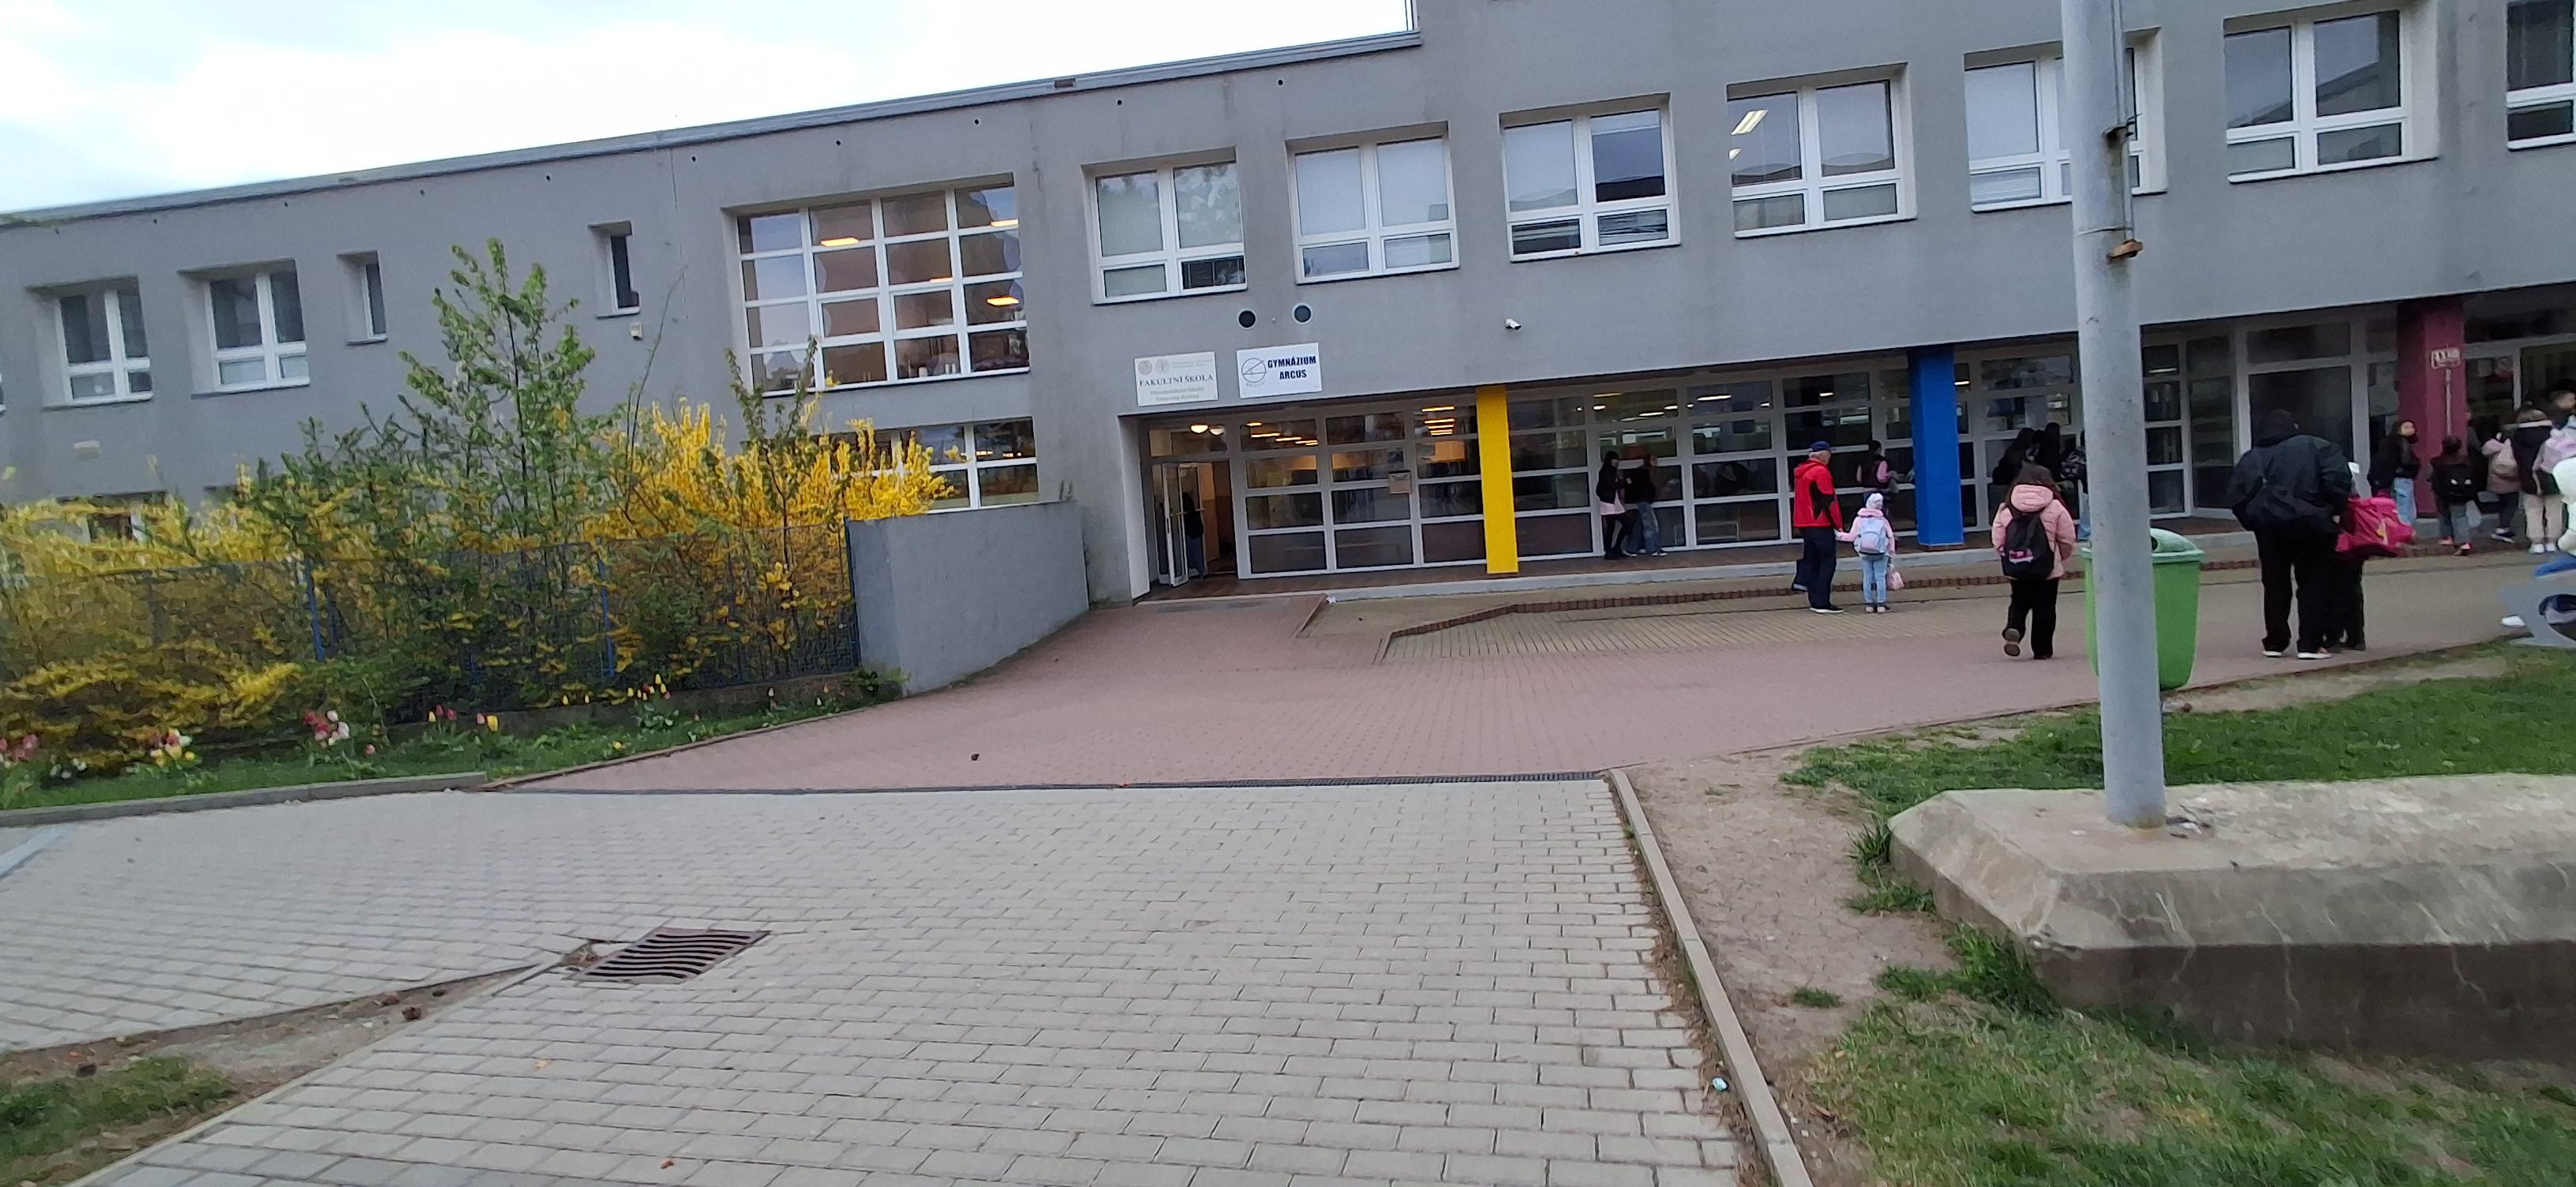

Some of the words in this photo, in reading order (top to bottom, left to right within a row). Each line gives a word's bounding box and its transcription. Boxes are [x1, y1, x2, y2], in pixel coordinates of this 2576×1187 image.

[1267, 355, 1316, 369] GYMNÁZIUM
[1185, 374, 1214, 383] ŠKOLA
[1279, 369, 1307, 380] ARCUS
